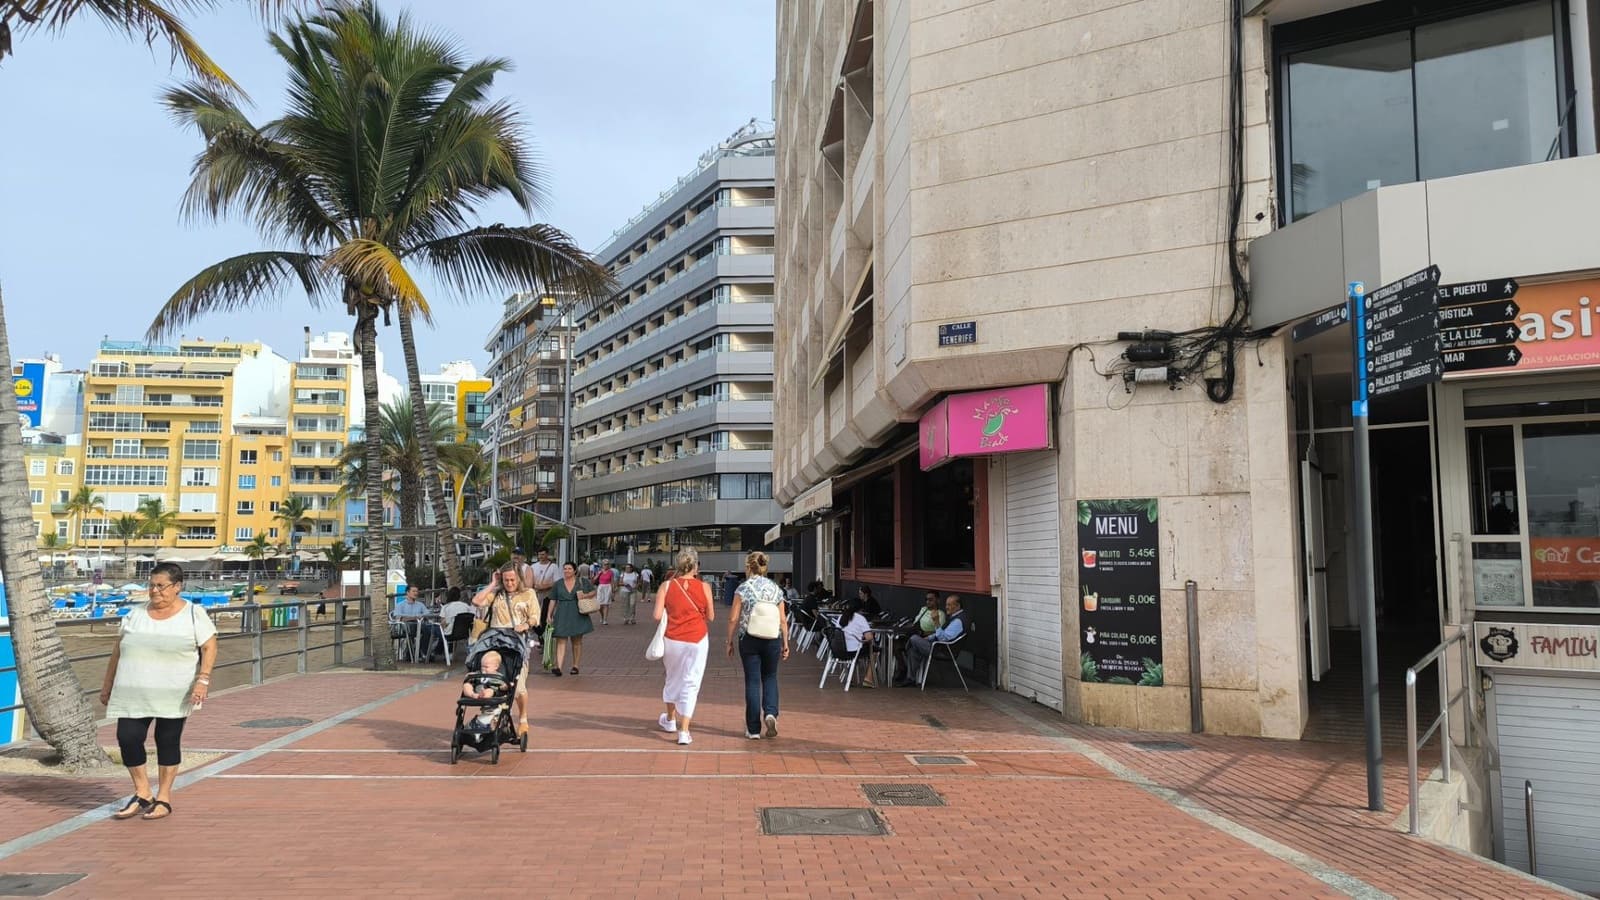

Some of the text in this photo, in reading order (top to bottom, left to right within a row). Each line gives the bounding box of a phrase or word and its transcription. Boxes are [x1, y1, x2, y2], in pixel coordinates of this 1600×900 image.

[1453, 282, 1488, 296] PUERTO
[1373, 303, 1403, 323] PLAYA CHICA
[1519, 296, 1600, 342] asi
[942, 333, 974, 345] TENERIFE
[1374, 335, 1381, 345] LA
[1449, 330, 1462, 341] LA
[1465, 328, 1482, 339] LUZ
[1375, 351, 1396, 366] ALFREDO
[1396, 346, 1412, 359] KRAUS
[1444, 352, 1465, 363] MAR
[1375, 374, 1396, 388] PALACIO
[1395, 371, 1403, 383] DE
[1402, 363, 1431, 380] CONGRESOS
[1095, 516, 1138, 535] MENU
[1099, 548, 1155, 559] MOJITO 5,45€
[1129, 594, 1156, 604] 6,00€
[1130, 634, 1157, 645] 6,00€
[1530, 636, 1597, 659] FAMILY
